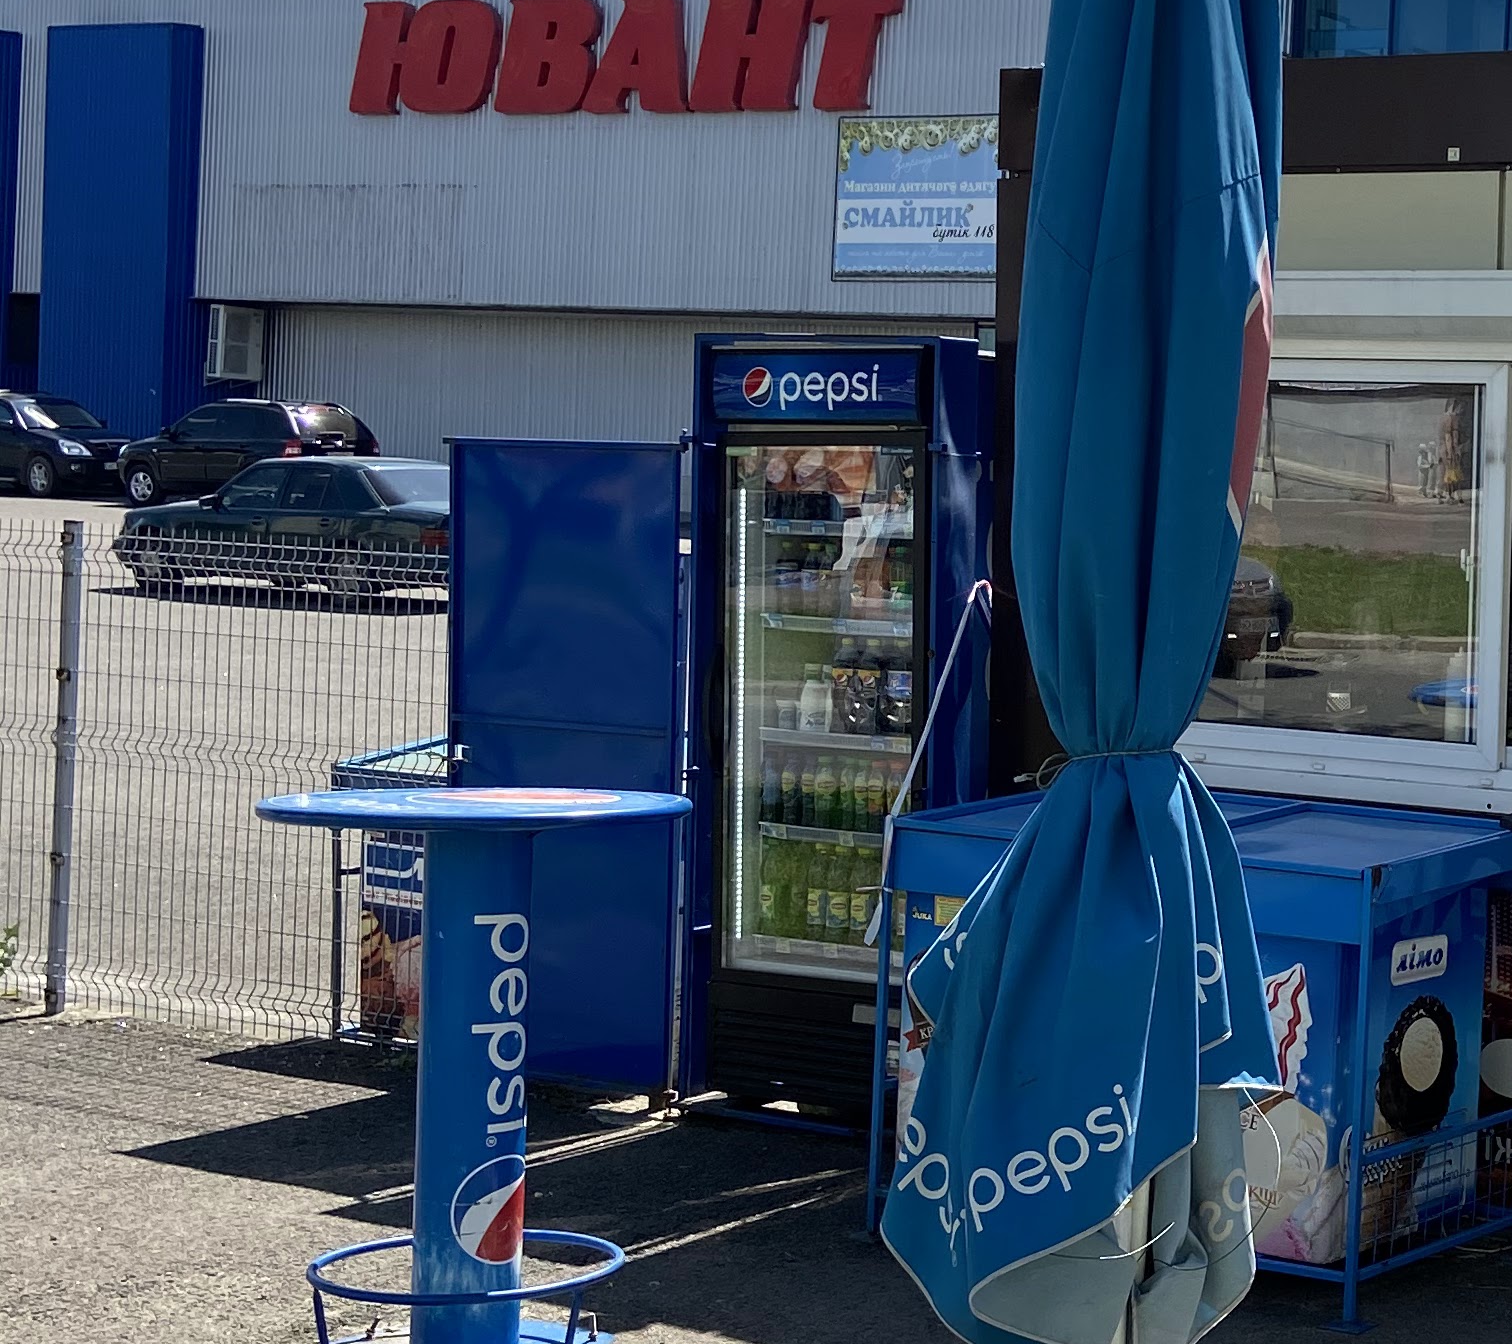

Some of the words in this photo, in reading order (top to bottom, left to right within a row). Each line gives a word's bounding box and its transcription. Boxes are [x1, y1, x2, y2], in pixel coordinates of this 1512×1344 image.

[844, 180, 896, 193] Магазин
[898, 181, 956, 195] дитячого
[960, 181, 996, 194] одягу
[844, 200, 971, 228] СМАЙЛИК
[933, 224, 971, 242] бутік
[780, 364, 882, 410] pepsi
[471, 914, 529, 1134] pepsi
[968, 1083, 1133, 1233] pepsi
